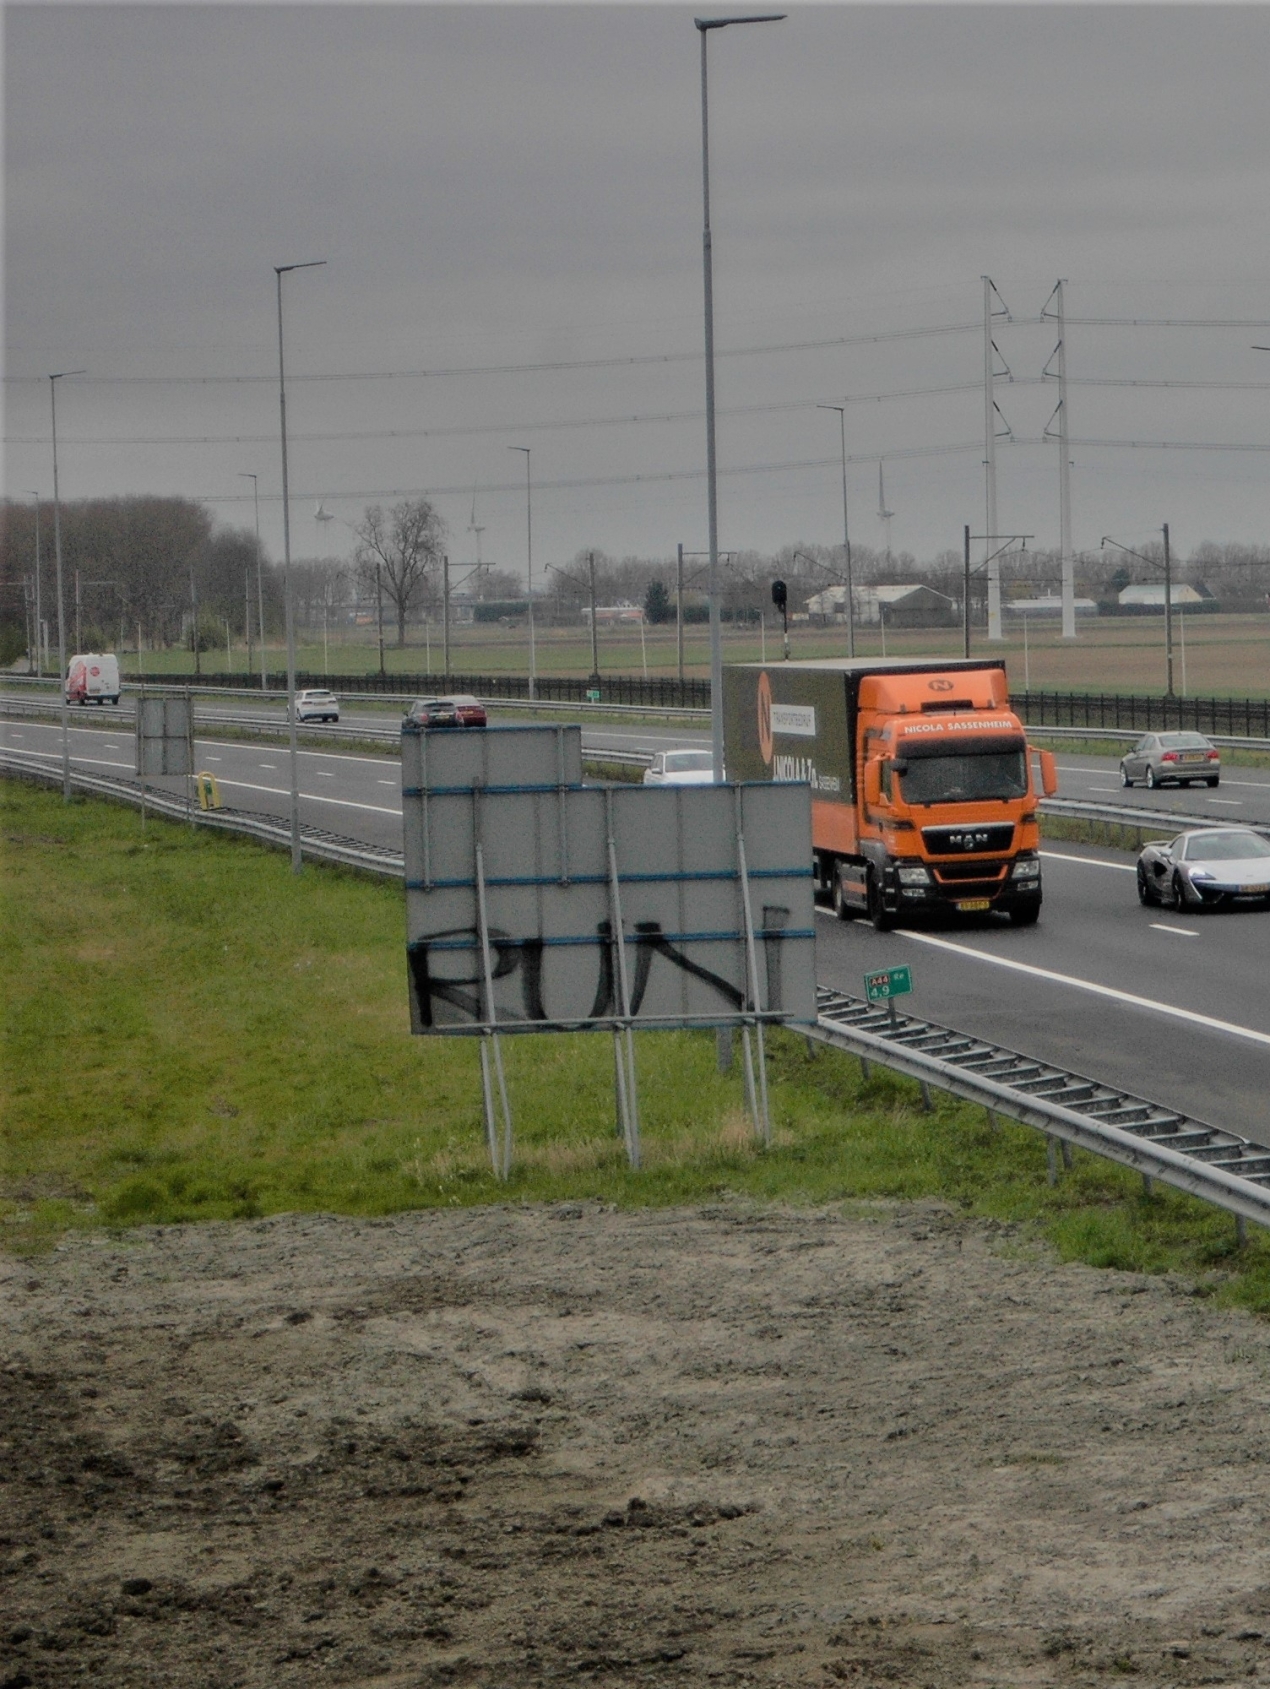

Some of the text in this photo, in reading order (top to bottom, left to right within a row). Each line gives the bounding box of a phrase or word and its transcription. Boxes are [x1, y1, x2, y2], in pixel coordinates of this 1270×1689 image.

[904, 721, 1012, 734] NICOLA SASSENHEIM
[949, 833, 988, 844] MAN
[871, 975, 889, 986] A44
